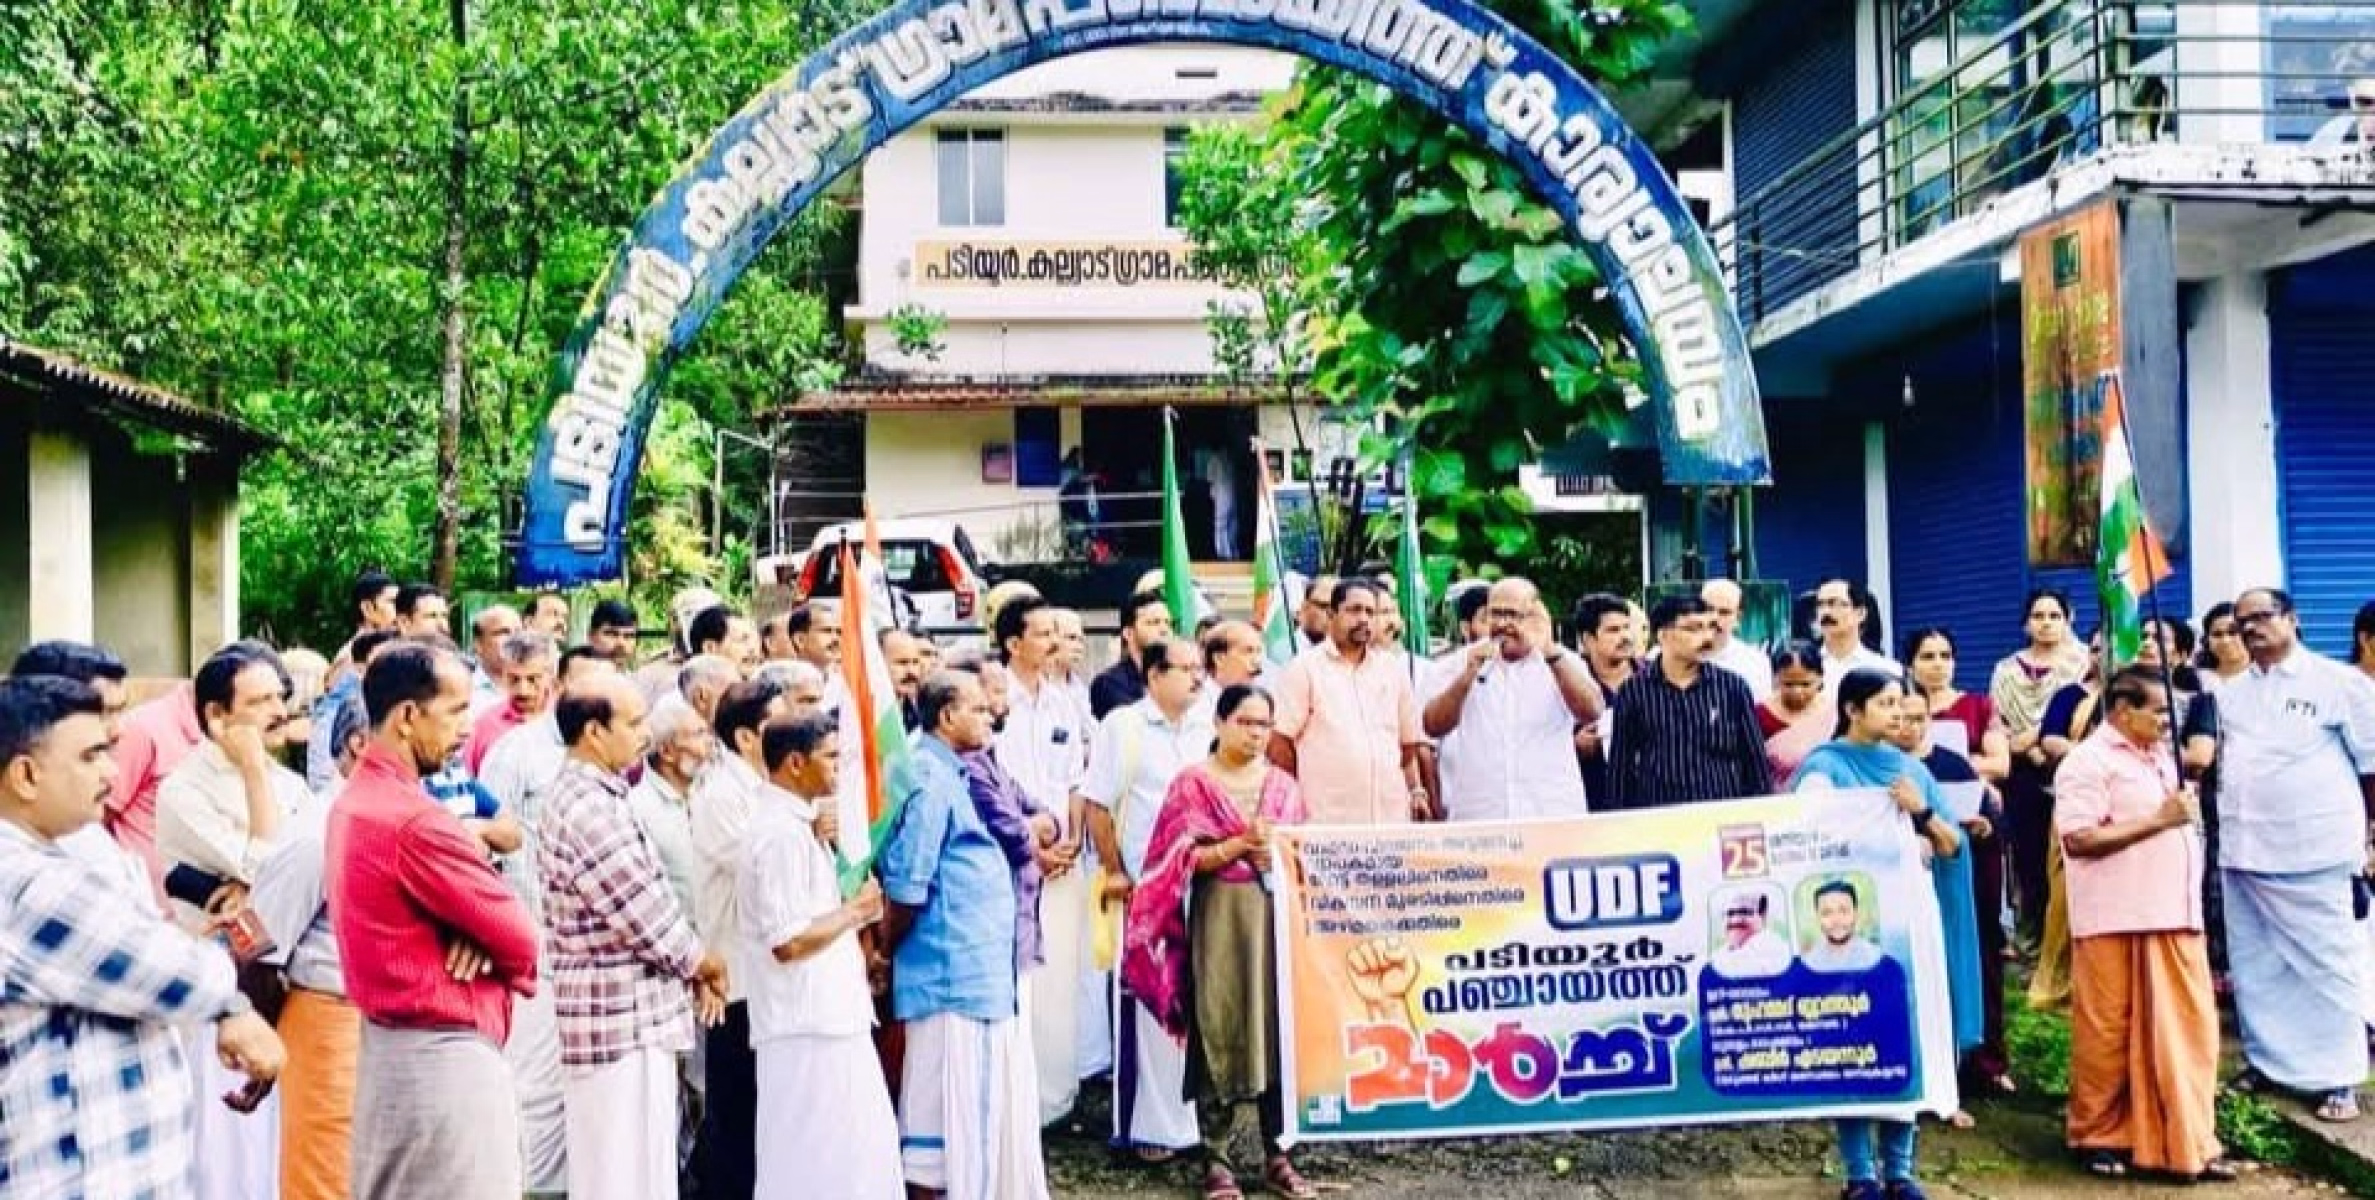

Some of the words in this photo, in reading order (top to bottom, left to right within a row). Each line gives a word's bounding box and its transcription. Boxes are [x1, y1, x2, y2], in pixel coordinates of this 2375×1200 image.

[1483, 70, 1723, 441] കാര്യാലയം
[1725, 840, 1765, 876] 25
[1551, 863, 1672, 922] UDF
[1445, 936, 1664, 971] പടിയൂർ
[1423, 954, 1696, 1014] പഞ്ചായത്ത്
[1344, 1012, 1692, 1111] മാർച്ച്
